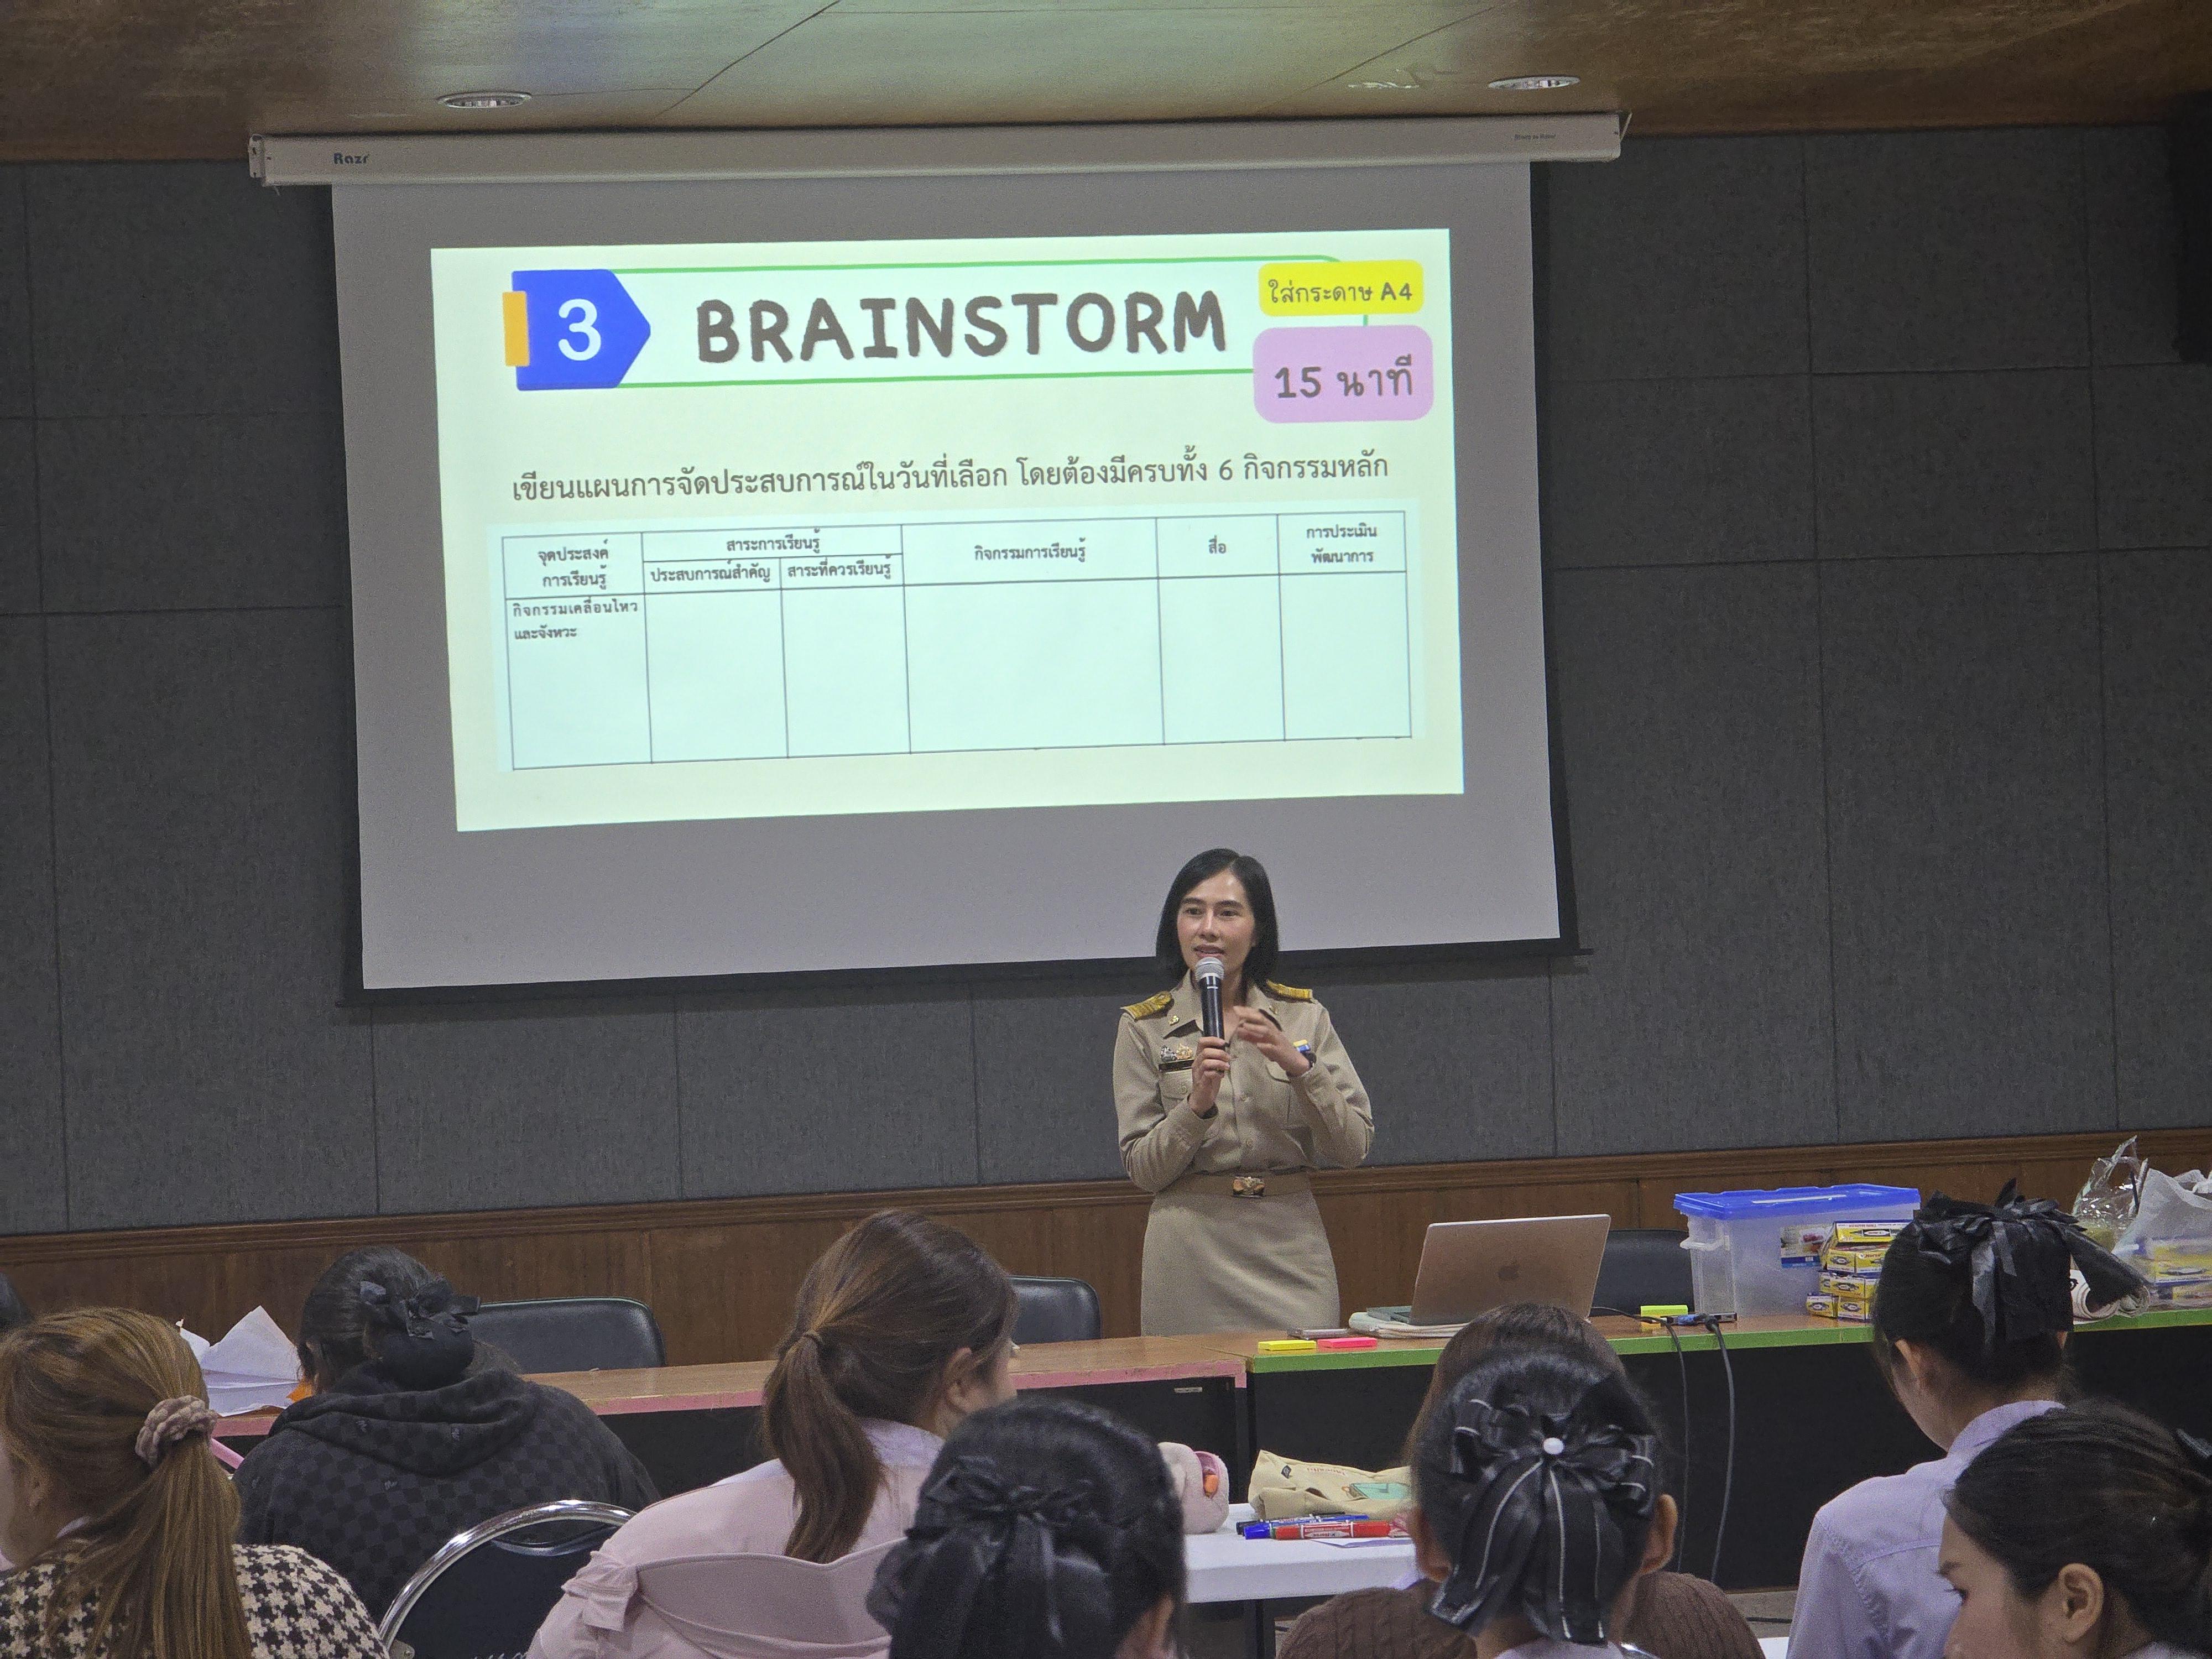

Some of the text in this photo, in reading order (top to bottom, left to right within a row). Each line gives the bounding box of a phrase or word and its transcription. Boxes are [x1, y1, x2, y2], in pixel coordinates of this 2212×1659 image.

[333, 153, 370, 164] Razr
[1268, 279, 1412, 304] ใส่กระดาษ A4
[558, 298, 602, 361] 3
[696, 290, 1225, 363] BRAINSTORM
[1274, 354, 1413, 399] 15 นาที
[513, 445, 1388, 502] เขียนแผนการจัดประสบการณ์ในวันที่เลือก โดยต้องมีครบทั้ง 6 กิจกรรมหลัก
[726, 527, 821, 554] สาระการเรียนรู้
[1306, 522, 1378, 539] การประเมิน
[538, 539, 608, 566] จุดประสงค์
[974, 538, 1086, 563] กิจกรรมการเรียนรู้
[1208, 535, 1227, 554] สื่อ
[1311, 547, 1374, 564] พัฒนาการ
[542, 565, 607, 590] การเรียนรู้
[650, 560, 771, 583] ประสบการณ์สำคัญ
[787, 555, 891, 580] สาระที่ควรเรียนรู้
[513, 597, 639, 617] กิจกรรมเคลื่อนไหว
[514, 624, 577, 640] และจังหวะ
